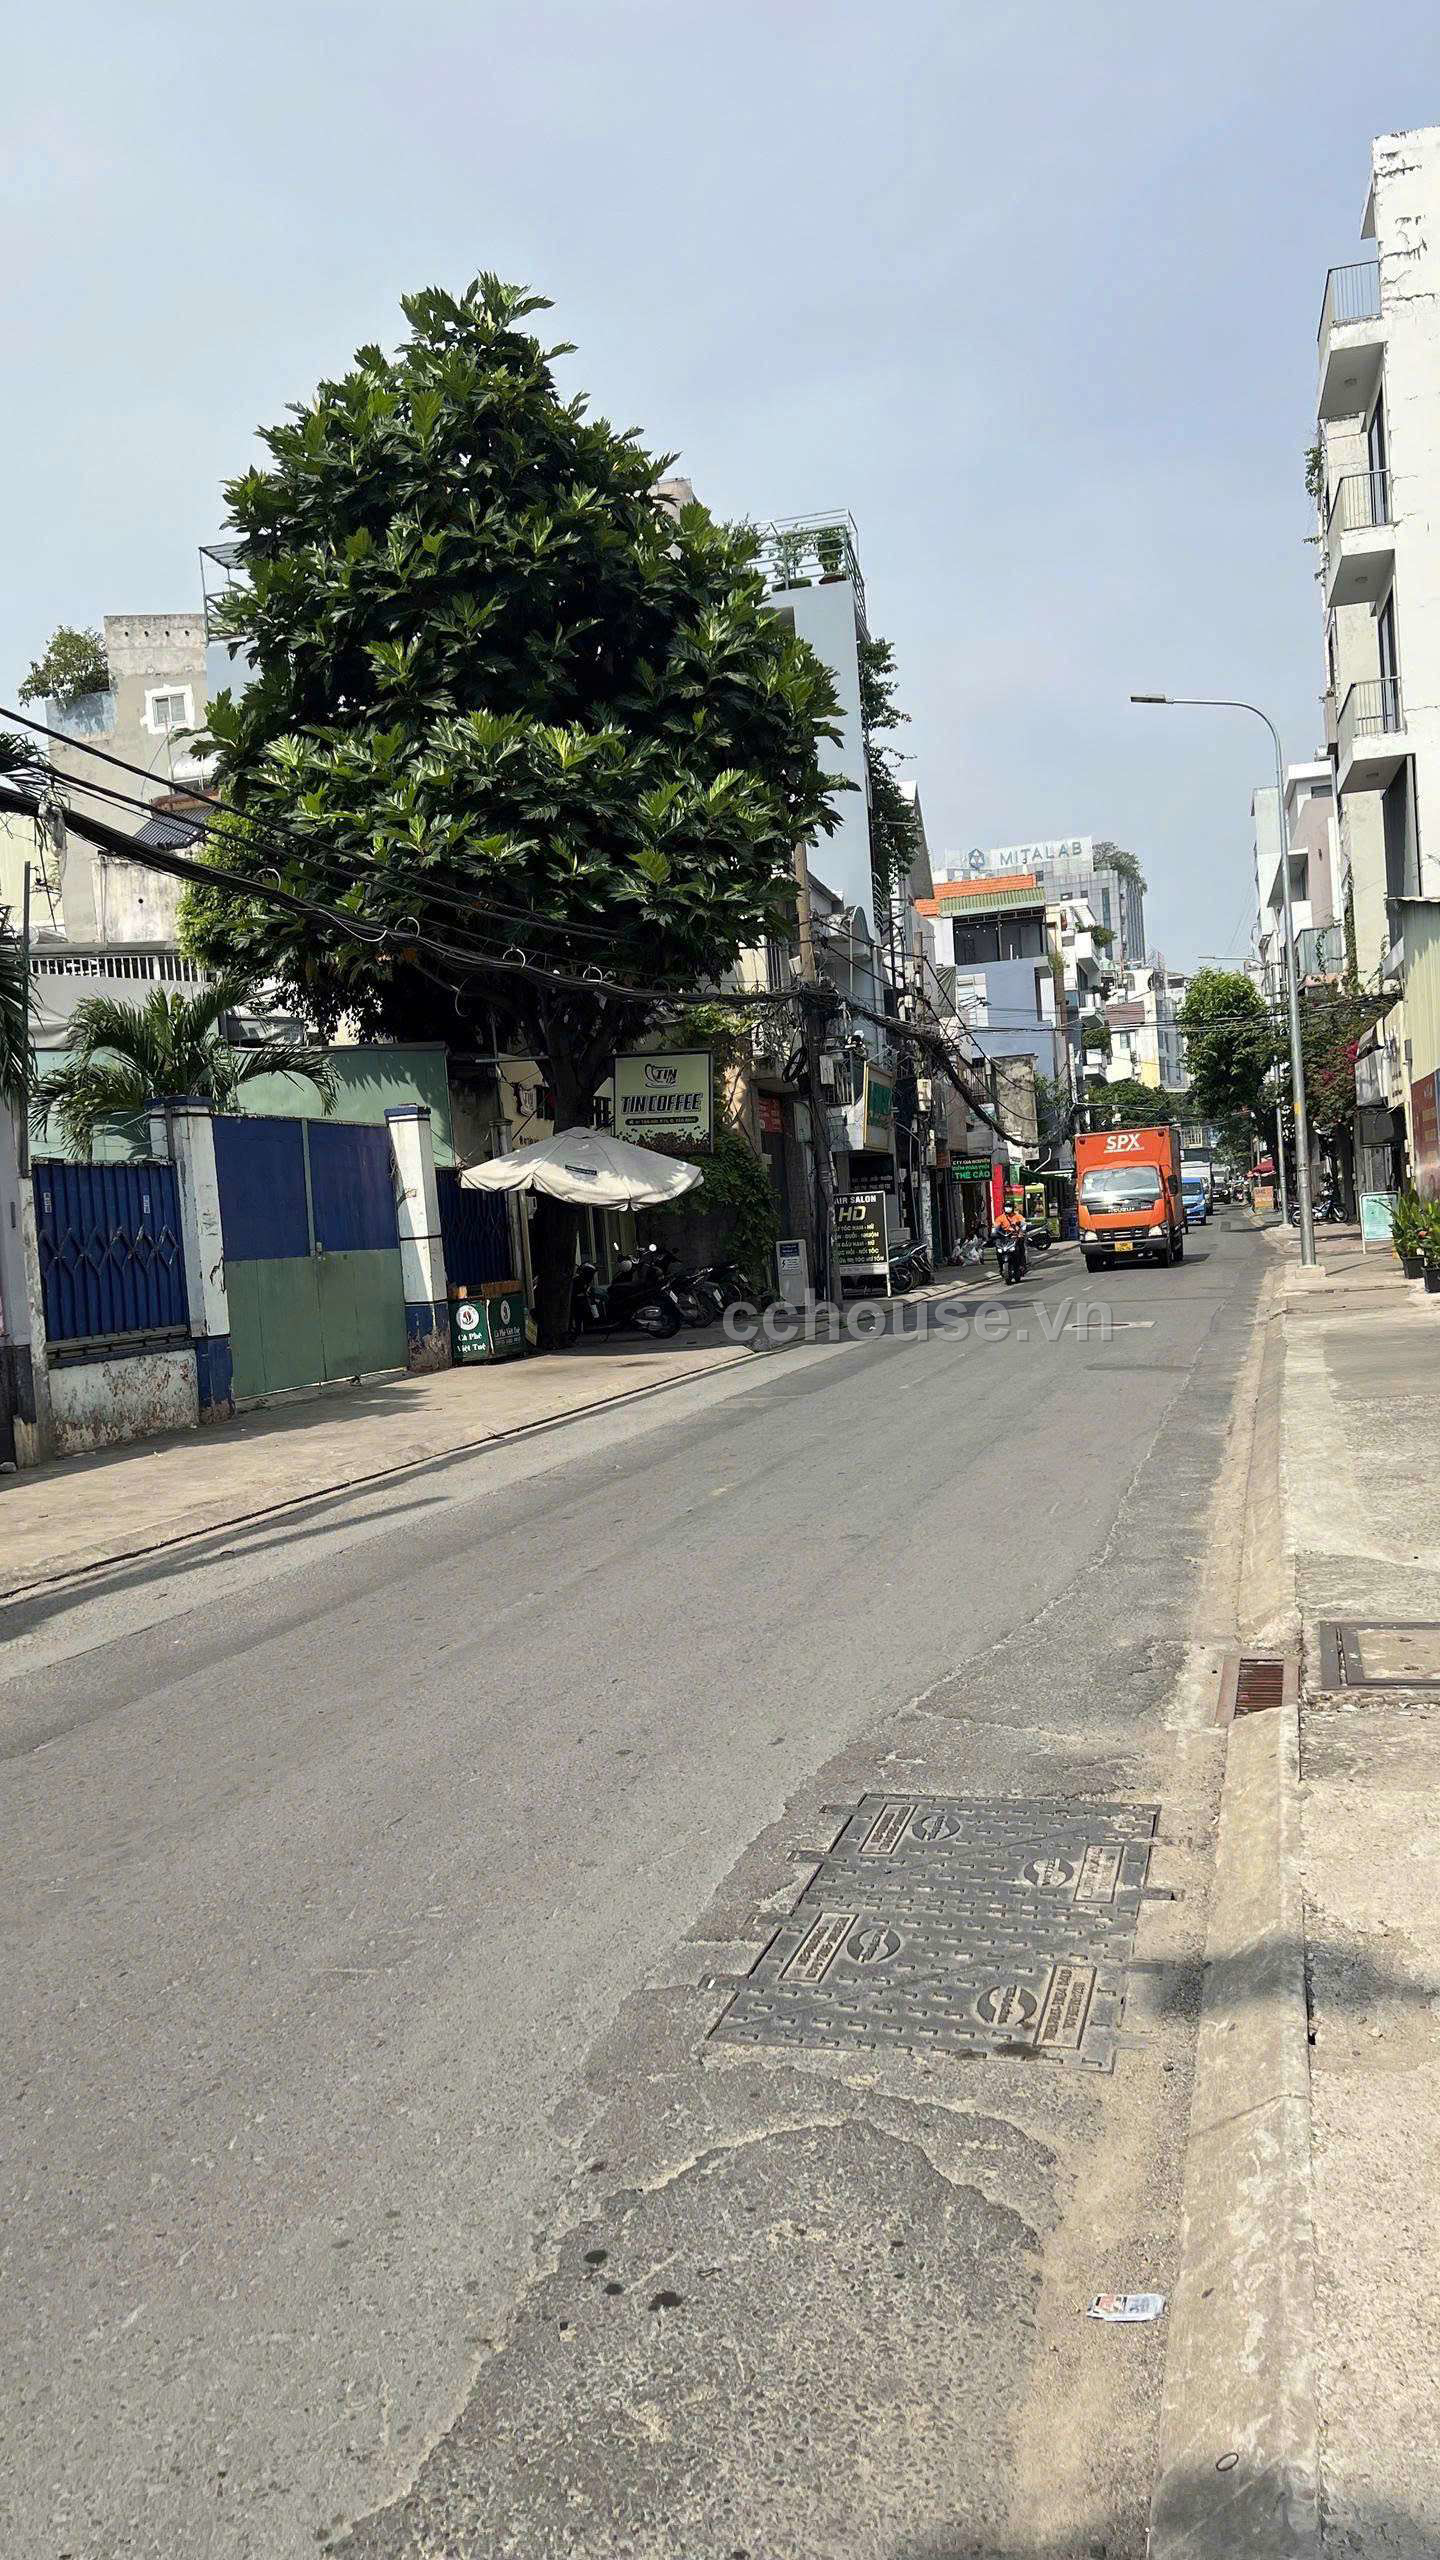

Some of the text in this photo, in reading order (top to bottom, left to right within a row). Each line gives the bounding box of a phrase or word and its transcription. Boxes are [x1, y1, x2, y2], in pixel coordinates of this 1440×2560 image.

[1000, 842, 1081, 865] MITALAB
[656, 1068, 677, 1080] TIN
[621, 1093, 703, 1113] TIN COFFEE
[1106, 1131, 1141, 1151] SPX
[850, 1195, 877, 1204] SALON
[839, 1206, 866, 1222] HD
